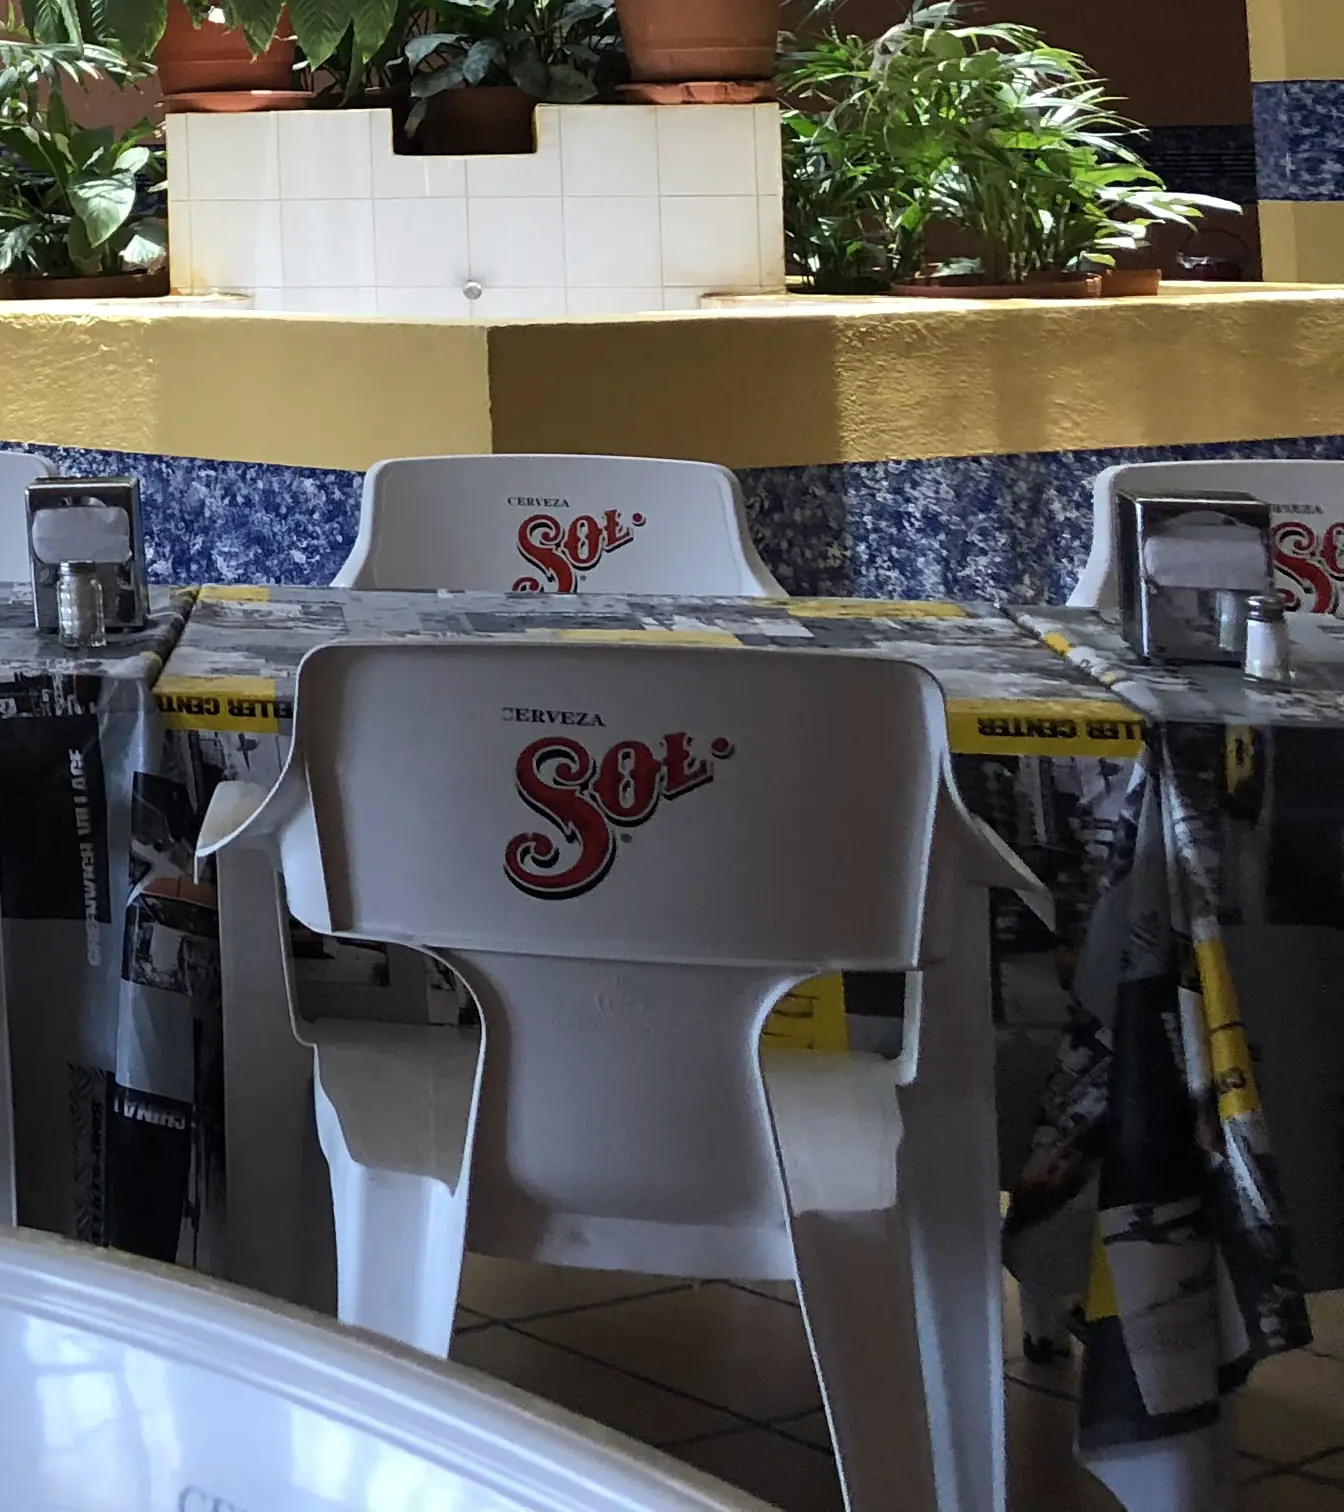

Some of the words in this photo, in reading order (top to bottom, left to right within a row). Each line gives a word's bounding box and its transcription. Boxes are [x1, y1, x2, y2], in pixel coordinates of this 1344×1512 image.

[507, 496, 570, 508] CERVEZA
[512, 509, 634, 595] SOL
[977, 717, 1079, 739] CENTER
[503, 731, 715, 901] SOL
